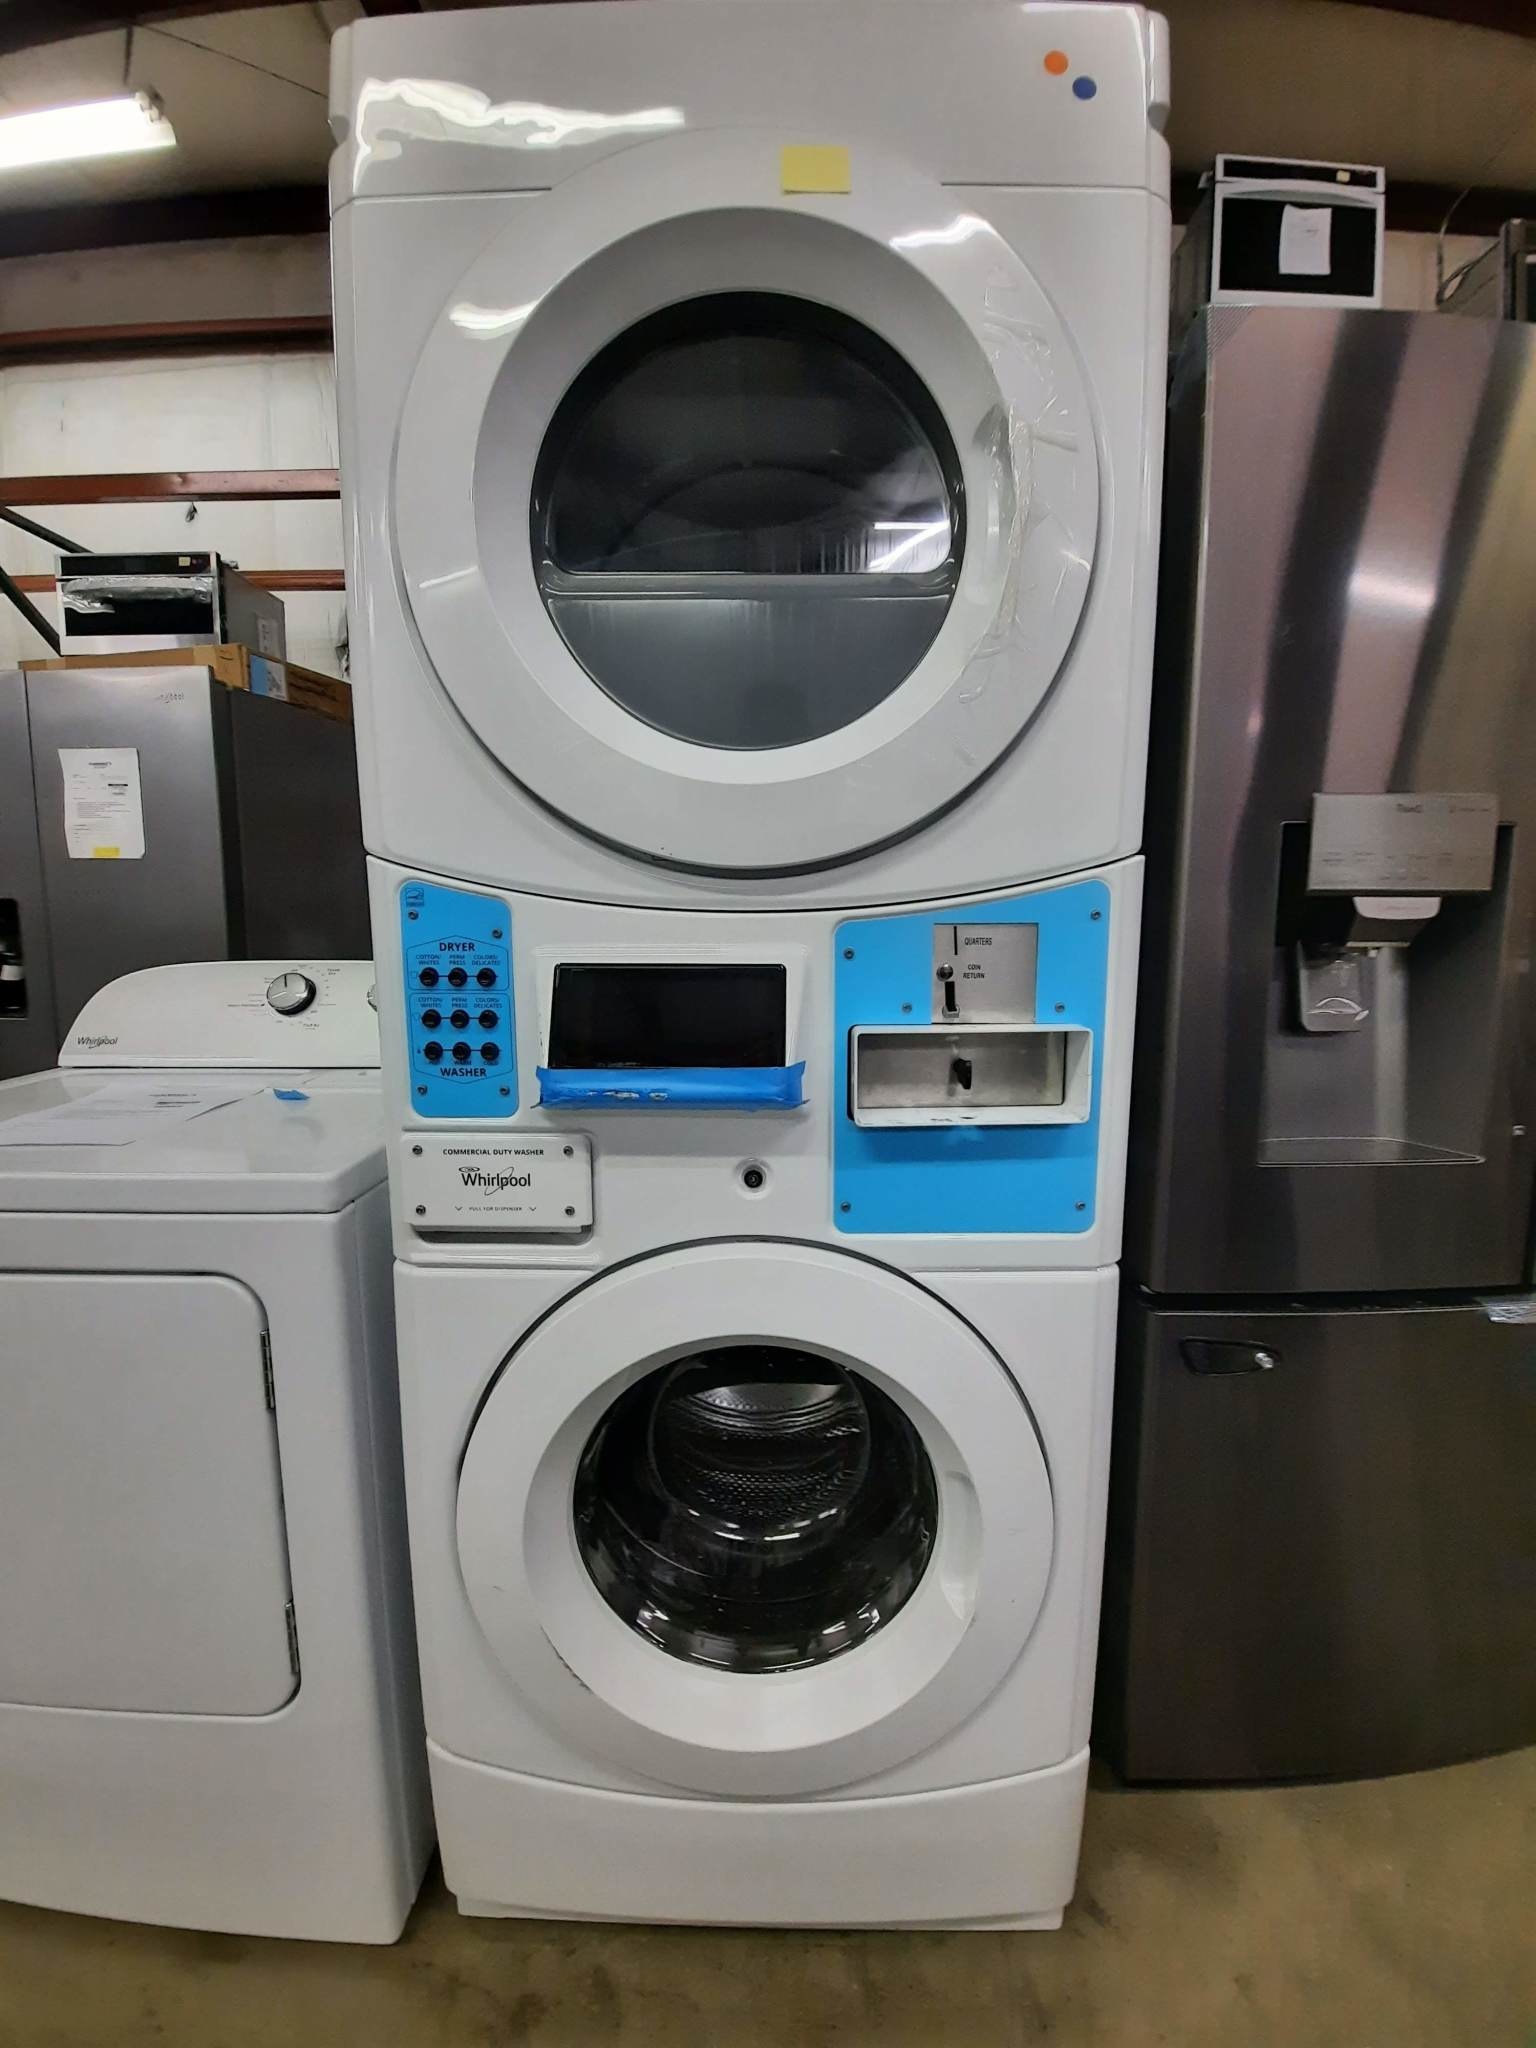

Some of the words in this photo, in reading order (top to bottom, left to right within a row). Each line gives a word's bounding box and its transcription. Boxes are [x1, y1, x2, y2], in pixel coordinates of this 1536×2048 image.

[964, 937, 993, 946] QUARTERS
[439, 942, 476, 952] DRYER
[440, 1067, 487, 1077] WASHER
[442, 1148, 491, 1156] COMMERCIAL
[493, 1148, 513, 1156] DUTY
[514, 1148, 545, 1156] WASHER
[461, 1171, 531, 1191] Whirlpool
